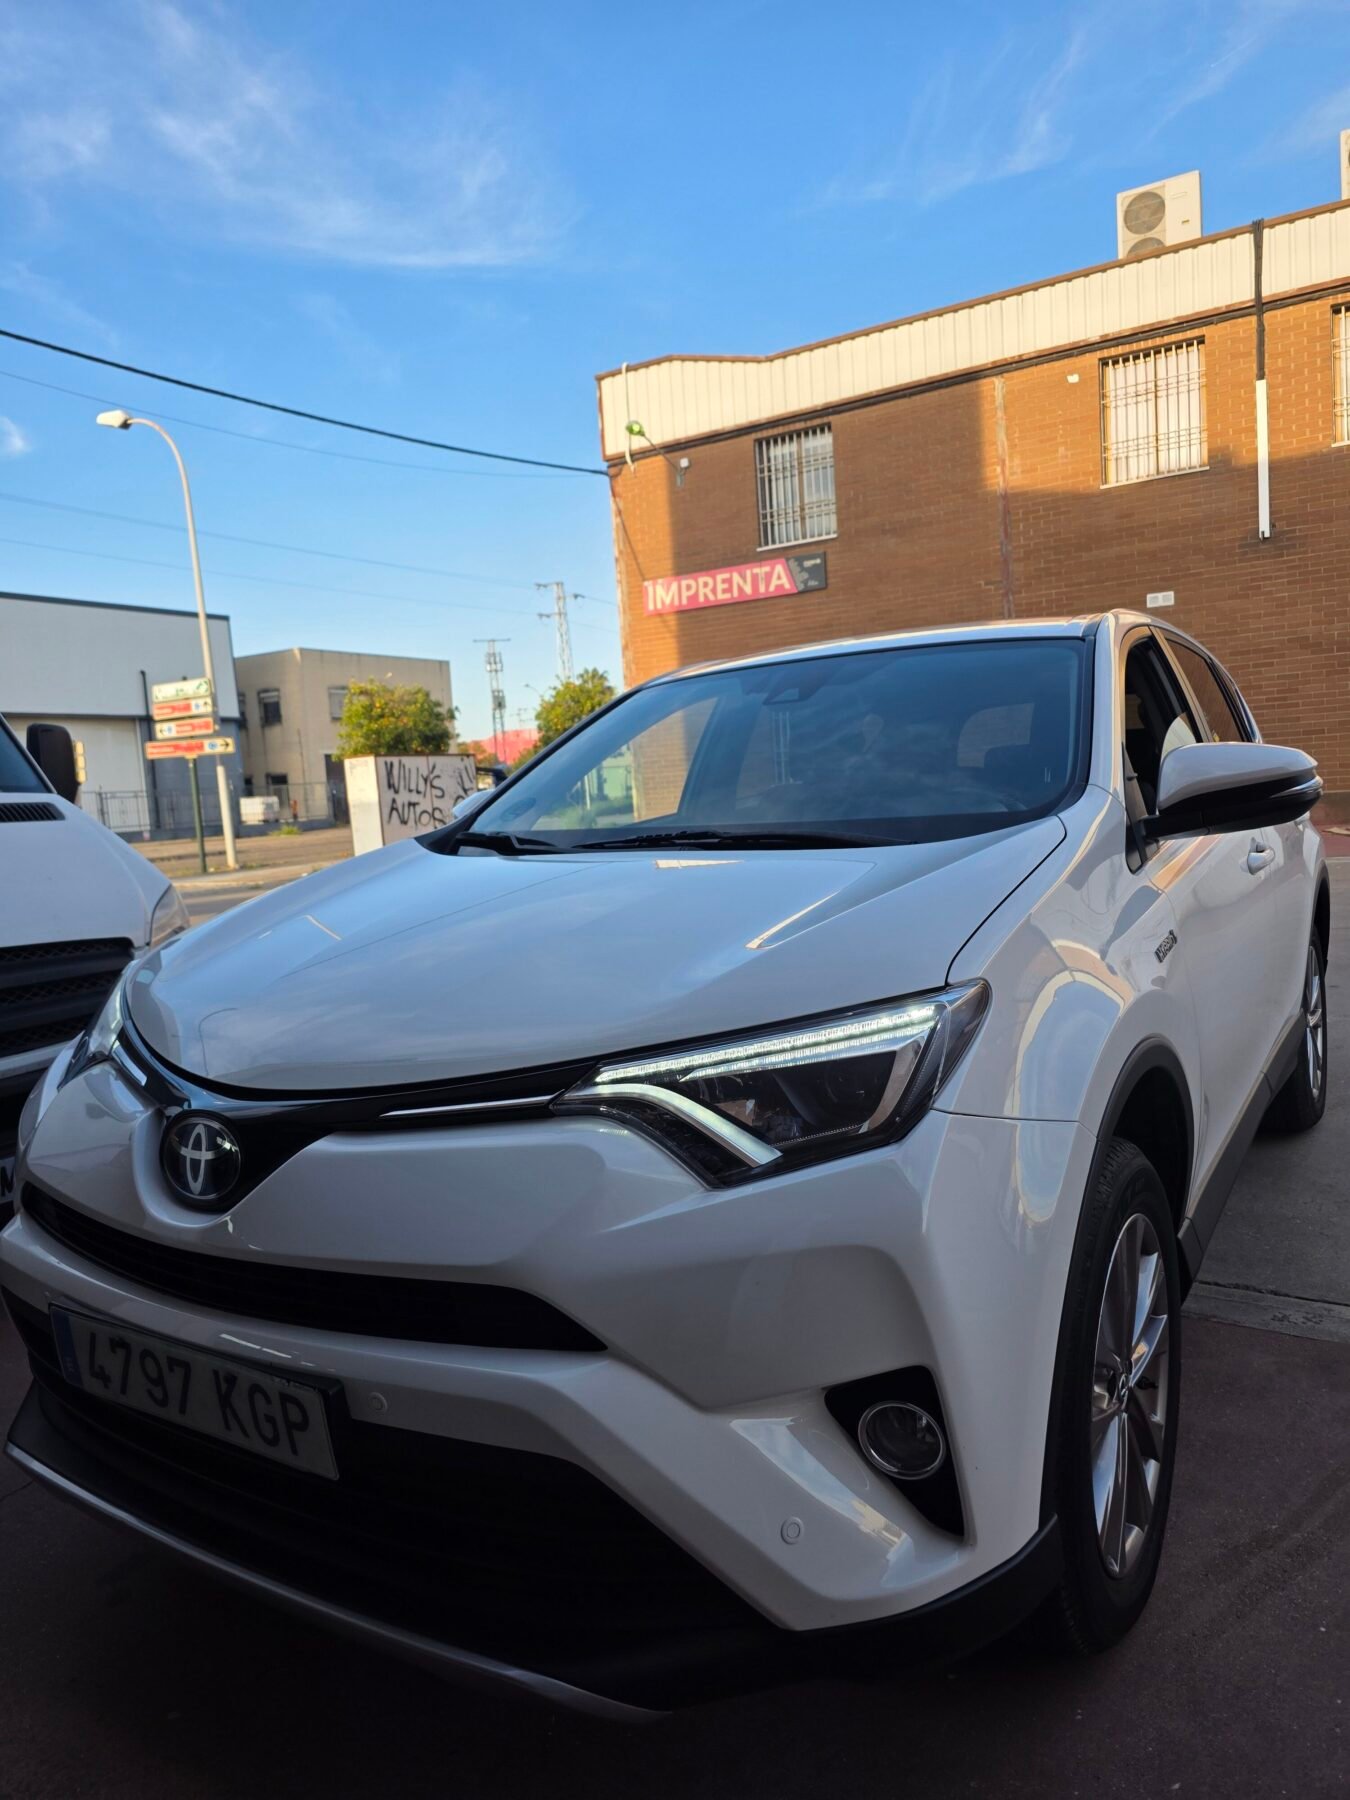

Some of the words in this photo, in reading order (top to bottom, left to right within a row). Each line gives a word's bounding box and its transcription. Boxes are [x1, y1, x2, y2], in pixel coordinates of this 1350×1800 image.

[646, 563, 791, 612] IMPRENTA
[88, 1331, 192, 1416] 4797
[212, 1368, 310, 1457] KGP
